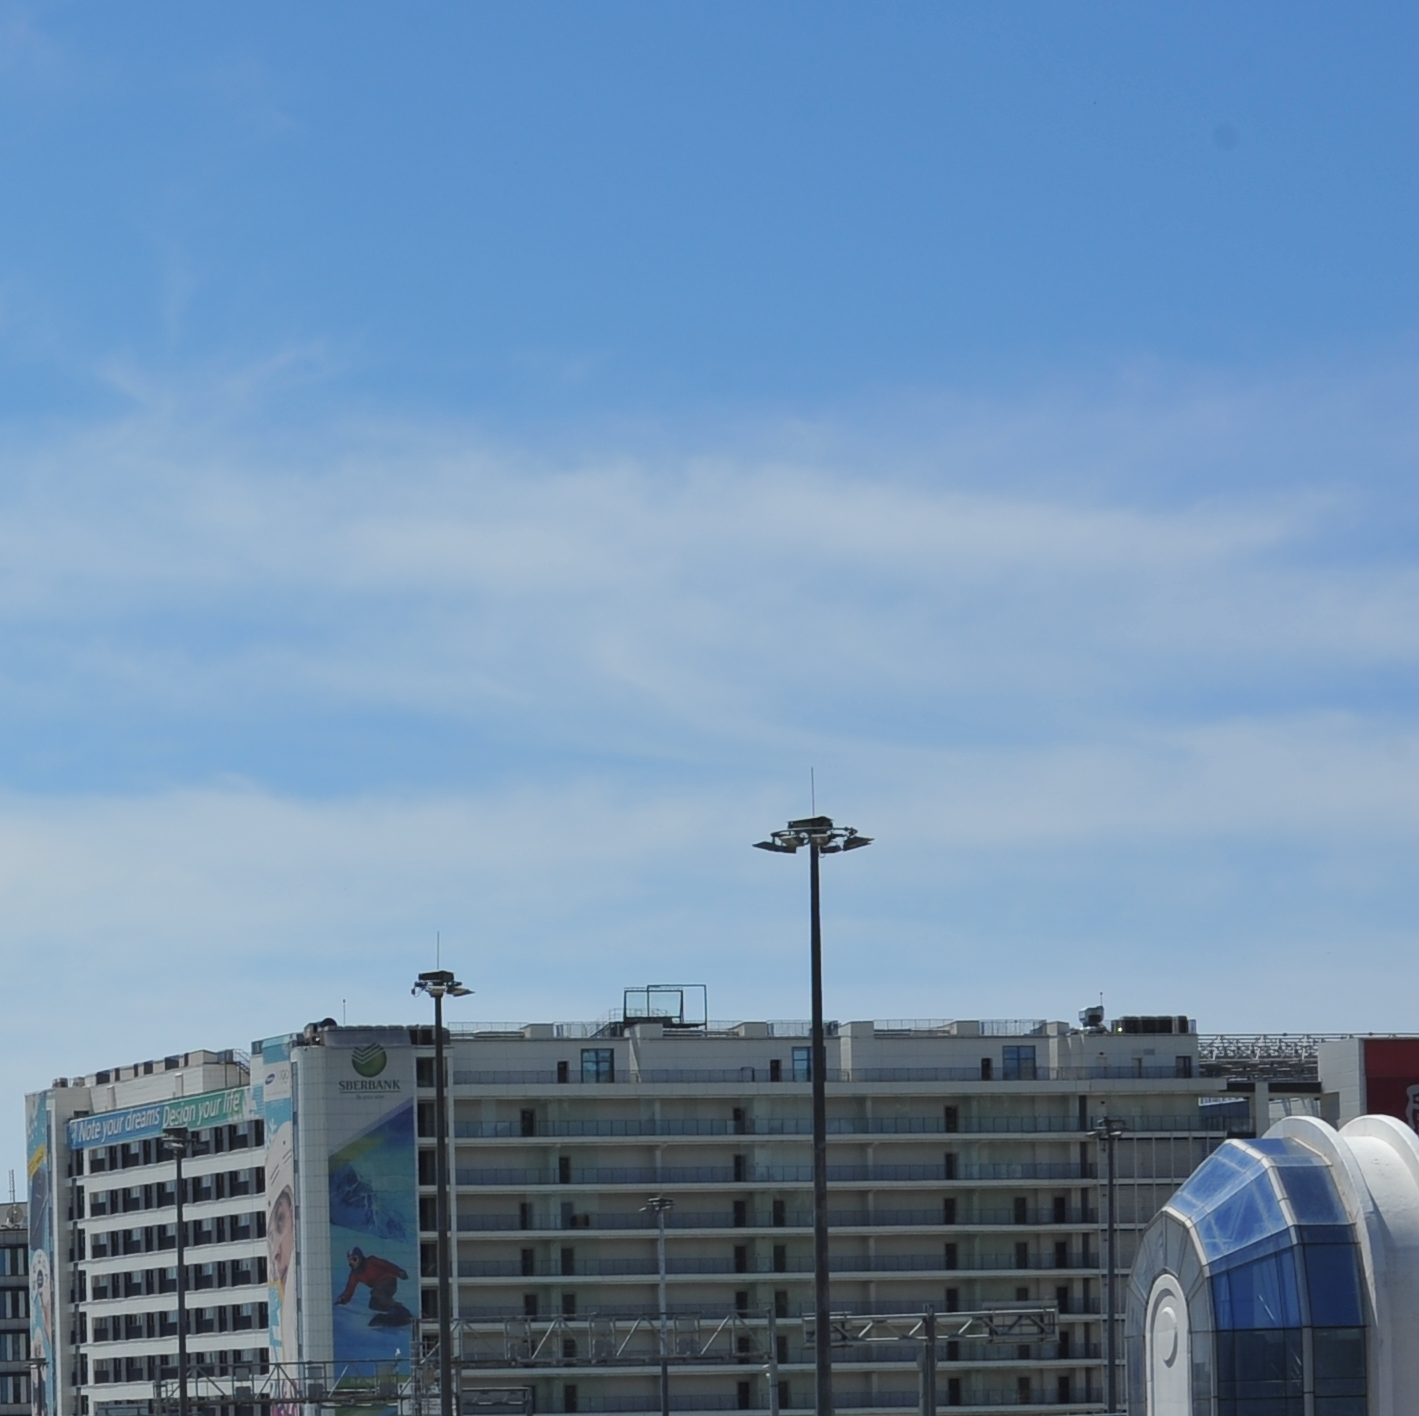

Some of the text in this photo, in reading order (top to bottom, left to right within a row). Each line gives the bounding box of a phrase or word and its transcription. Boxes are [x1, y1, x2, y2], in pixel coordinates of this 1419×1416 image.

[338, 1079, 401, 1091] SBERBANK
[78, 1091, 240, 1143] Note your dreams Design your life
